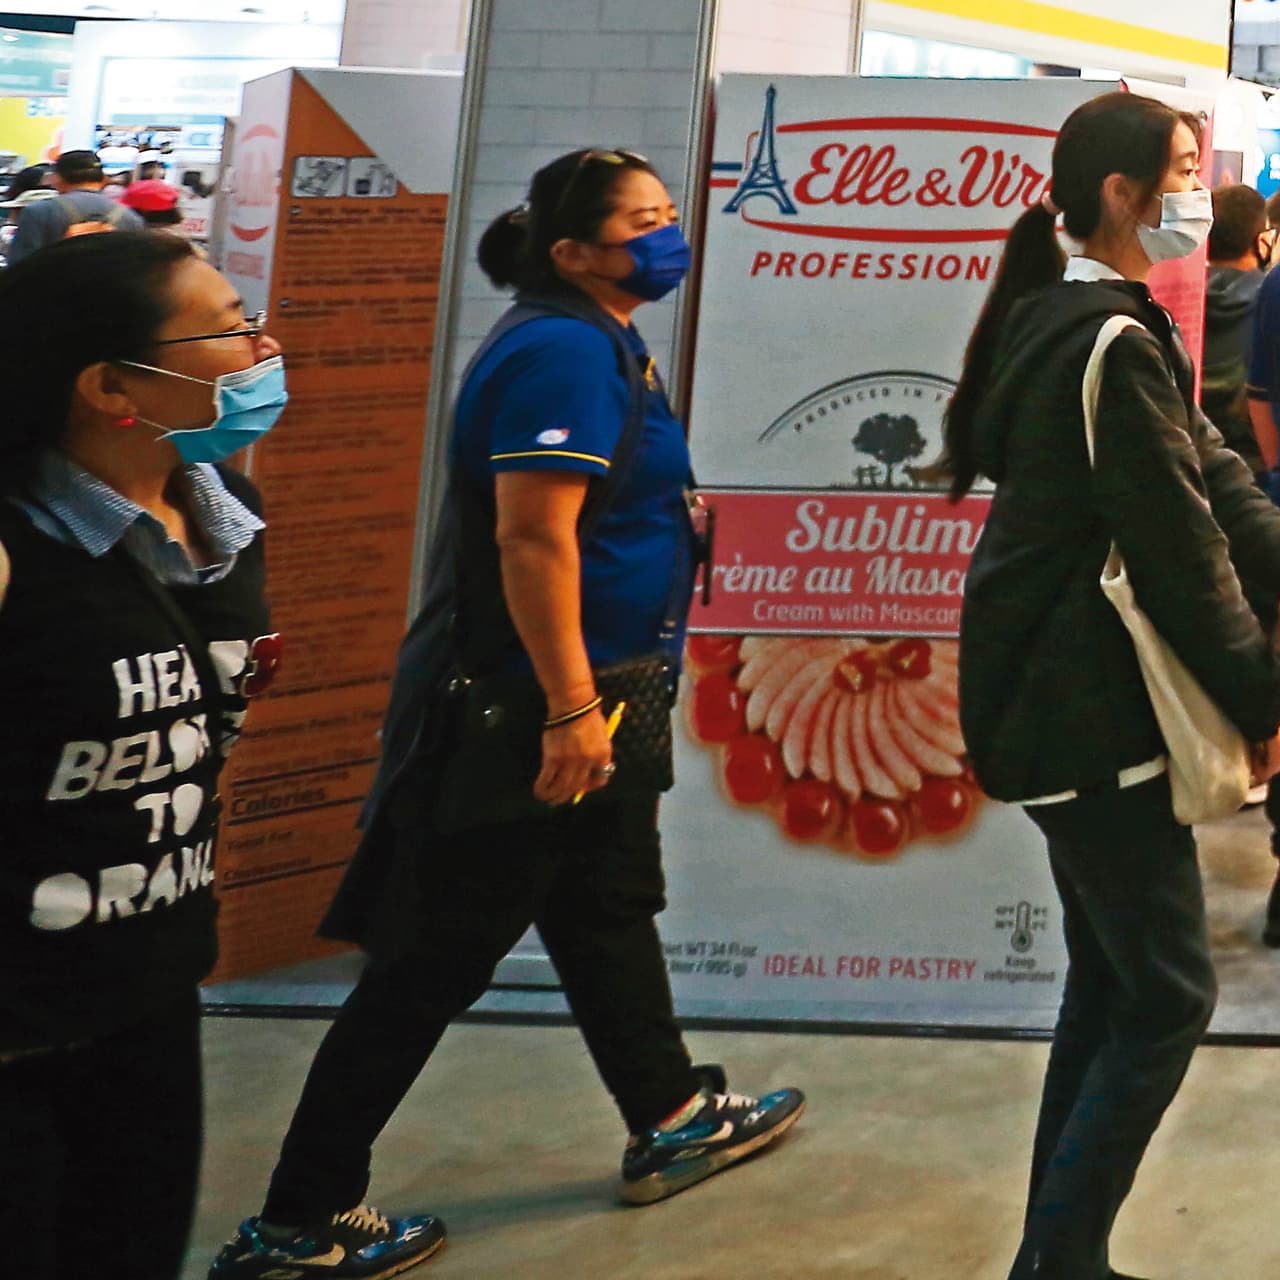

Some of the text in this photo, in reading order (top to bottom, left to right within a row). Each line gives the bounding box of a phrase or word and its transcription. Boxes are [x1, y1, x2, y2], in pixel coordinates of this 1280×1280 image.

[794, 143, 910, 207] Elle
[915, 168, 953, 207] &
[804, 564, 856, 595] au
[753, 599, 961, 625] Cream with Mascar
[134, 782, 204, 843] TO
[764, 955, 976, 980] IDEAL FOR PASTRY
